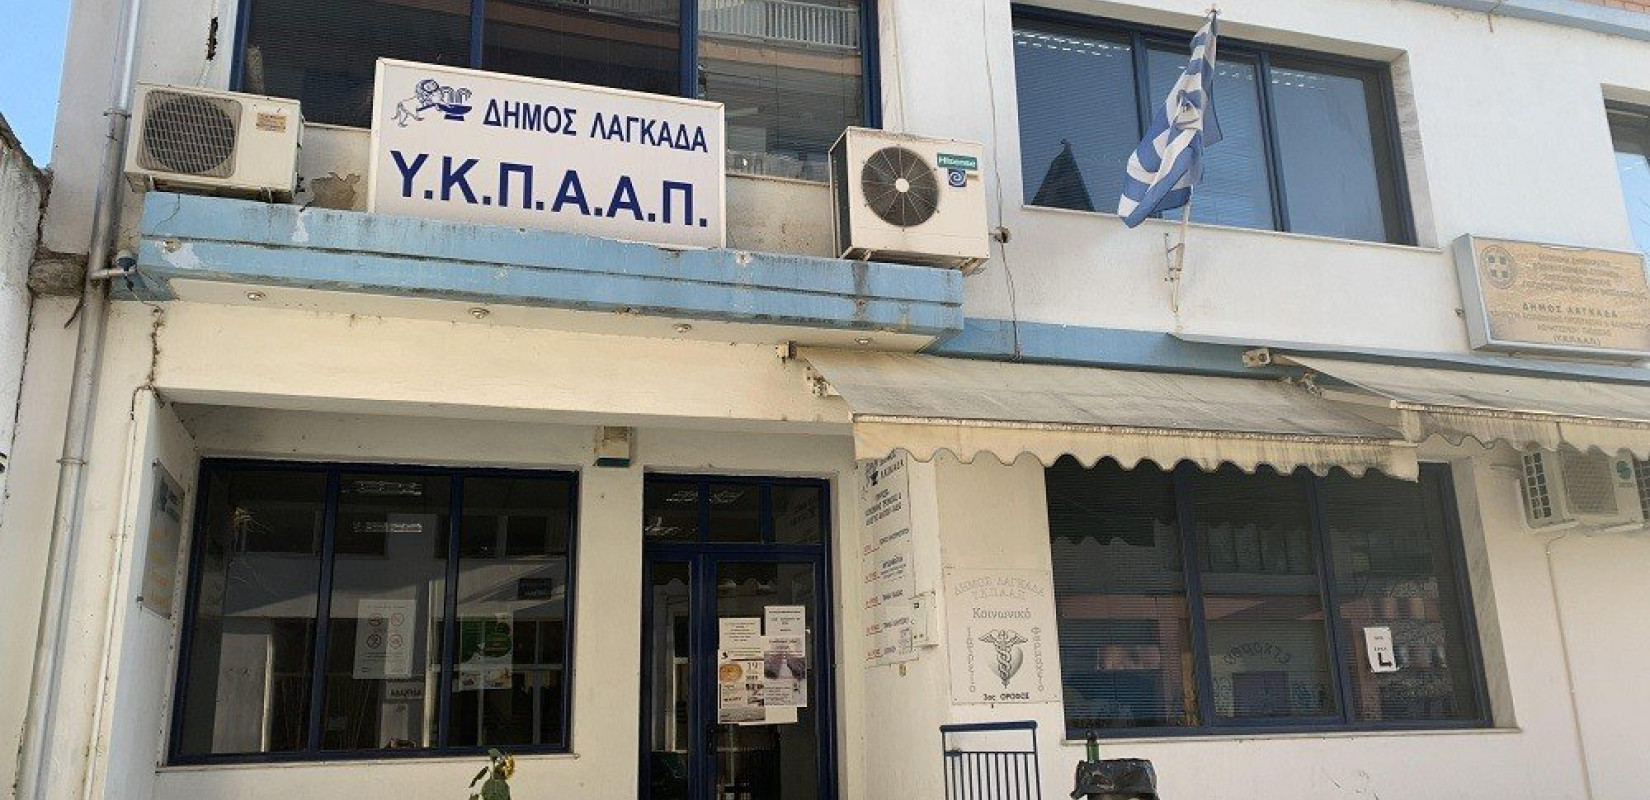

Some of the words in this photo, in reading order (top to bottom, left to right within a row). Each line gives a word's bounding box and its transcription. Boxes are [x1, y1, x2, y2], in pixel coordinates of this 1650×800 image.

[483, 99, 577, 136] ΔΗΜΟΣ
[590, 112, 709, 153] ΛΑΓΚΑΔΑ
[390, 150, 708, 227] Υ.Κ.Π.Α.Α.Π.
[1522, 302, 1562, 314] ΔΗΜΟΣ
[972, 607, 1032, 620] Κοινωνικό
